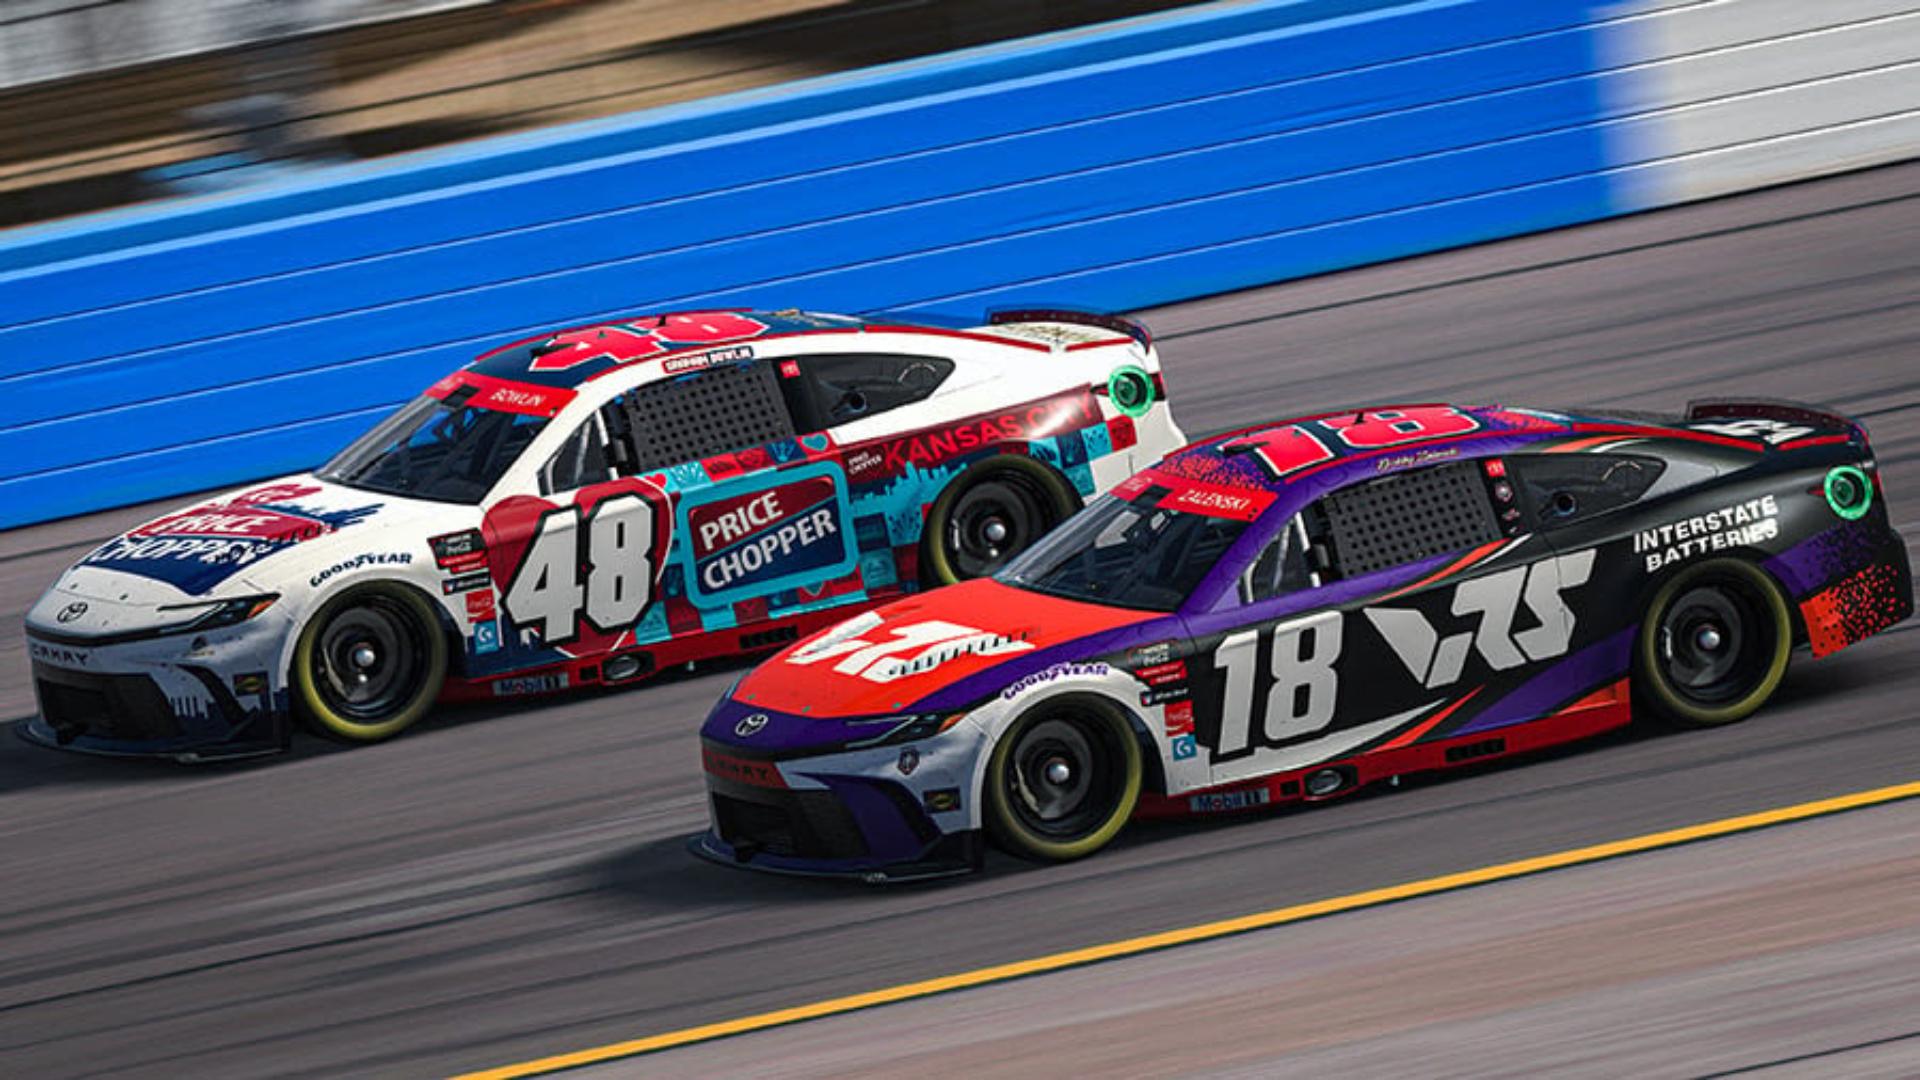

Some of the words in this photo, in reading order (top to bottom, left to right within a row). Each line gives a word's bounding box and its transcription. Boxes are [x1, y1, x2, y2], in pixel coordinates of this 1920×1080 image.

[490, 388, 544, 406] BOWLIN
[882, 414, 1021, 470] KANSAS
[1217, 407, 1480, 477] 18
[700, 490, 784, 551] PRICE
[1178, 489, 1250, 510] ZALENSKI
[1634, 494, 1778, 553] INTERSTATE
[309, 552, 412, 587] GOODYEAR
[505, 494, 653, 642] 48
[703, 508, 837, 589] CHOPPER
[1646, 517, 1778, 573] BATTERIES
[1003, 662, 1109, 700] GOODYEAR
[1214, 608, 1344, 755] 18
